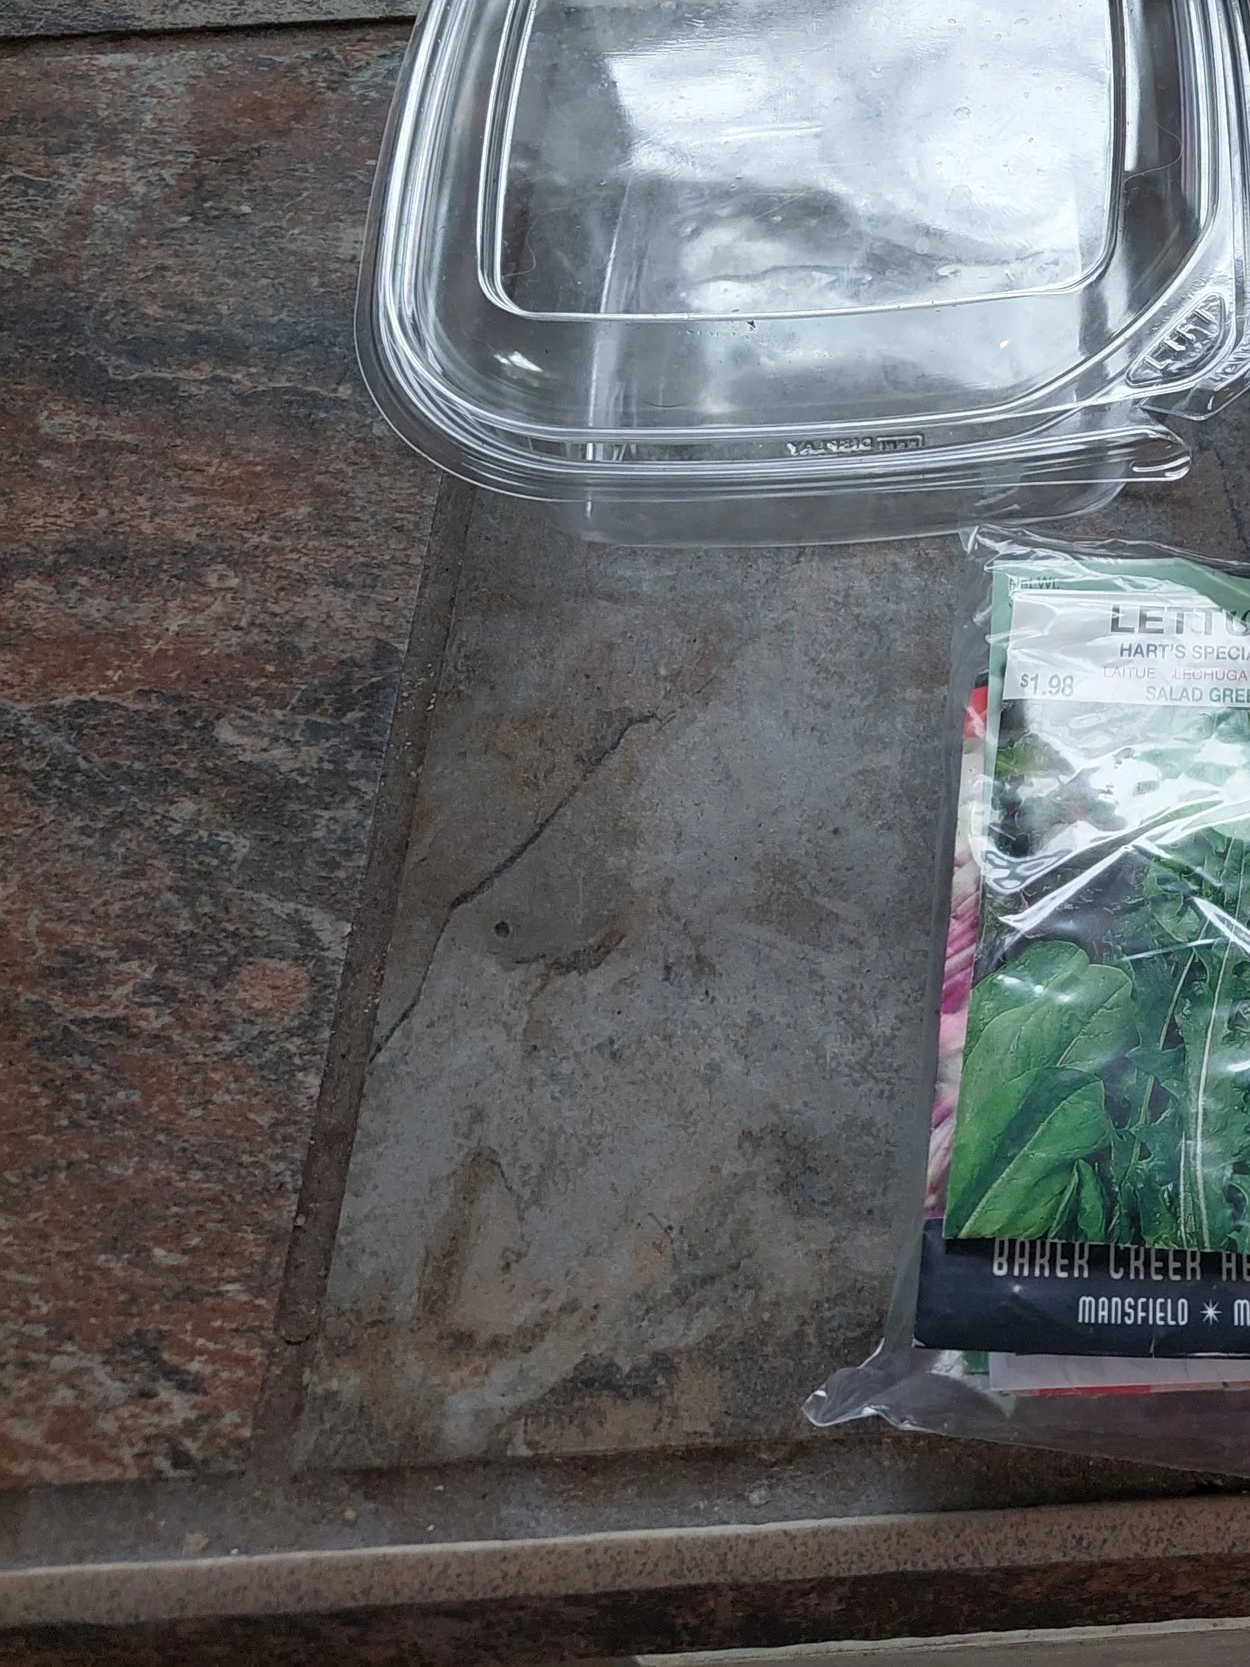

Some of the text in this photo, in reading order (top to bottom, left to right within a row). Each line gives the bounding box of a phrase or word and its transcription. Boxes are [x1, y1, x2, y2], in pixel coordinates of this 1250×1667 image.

[1119, 642, 1186, 660] HART'S
[1103, 666, 1156, 680] LAITUE
[1019, 672, 1075, 697] $1.98
[1146, 685, 1203, 703] SALAD
[991, 1238, 1090, 1279] BAKER
[1108, 1242, 1202, 1282] CREEK
[1077, 1295, 1189, 1326] MANSFIELD
